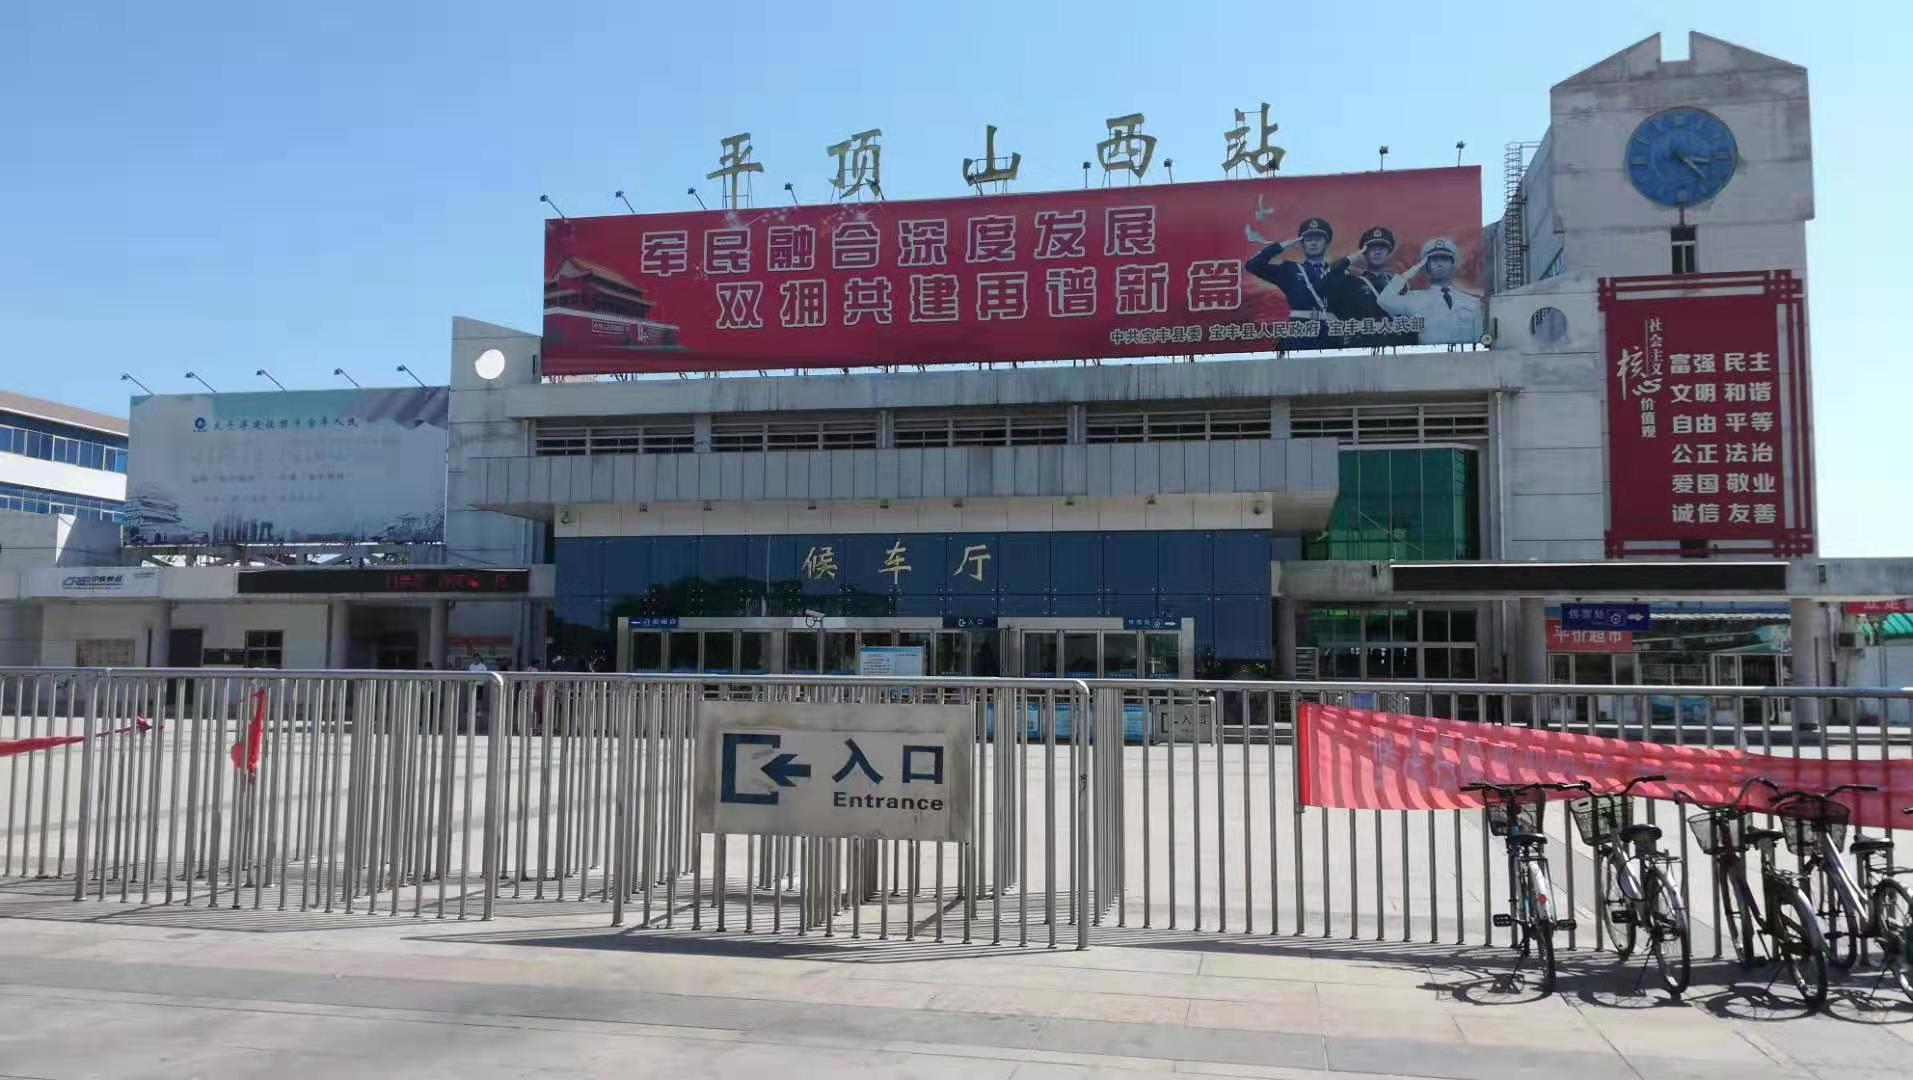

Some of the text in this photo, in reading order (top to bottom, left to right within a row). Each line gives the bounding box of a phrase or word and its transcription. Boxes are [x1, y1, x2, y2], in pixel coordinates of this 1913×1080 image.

[706, 102, 1287, 208] 平顶山西站
[641, 206, 1158, 276] 军民融合深度发展
[716, 259, 1242, 330] 双拥共建再谱新篇
[1110, 326, 1202, 344] 中共宝丰县委
[1209, 320, 1320, 341] 宝丰县人民政府
[1670, 351, 1771, 375] 富强 民主
[1670, 382, 1772, 404] 文明 和谐
[1672, 411, 1774, 434] 自由 平等
[1671, 442, 1773, 464] 公正 法治
[1672, 472, 1776, 494] 爱国 敬业
[1672, 503, 1776, 524] 诚信 友善
[802, 540, 991, 584] 候车厅
[832, 738, 944, 785] 入口
[832, 791, 944, 812] Entrance
